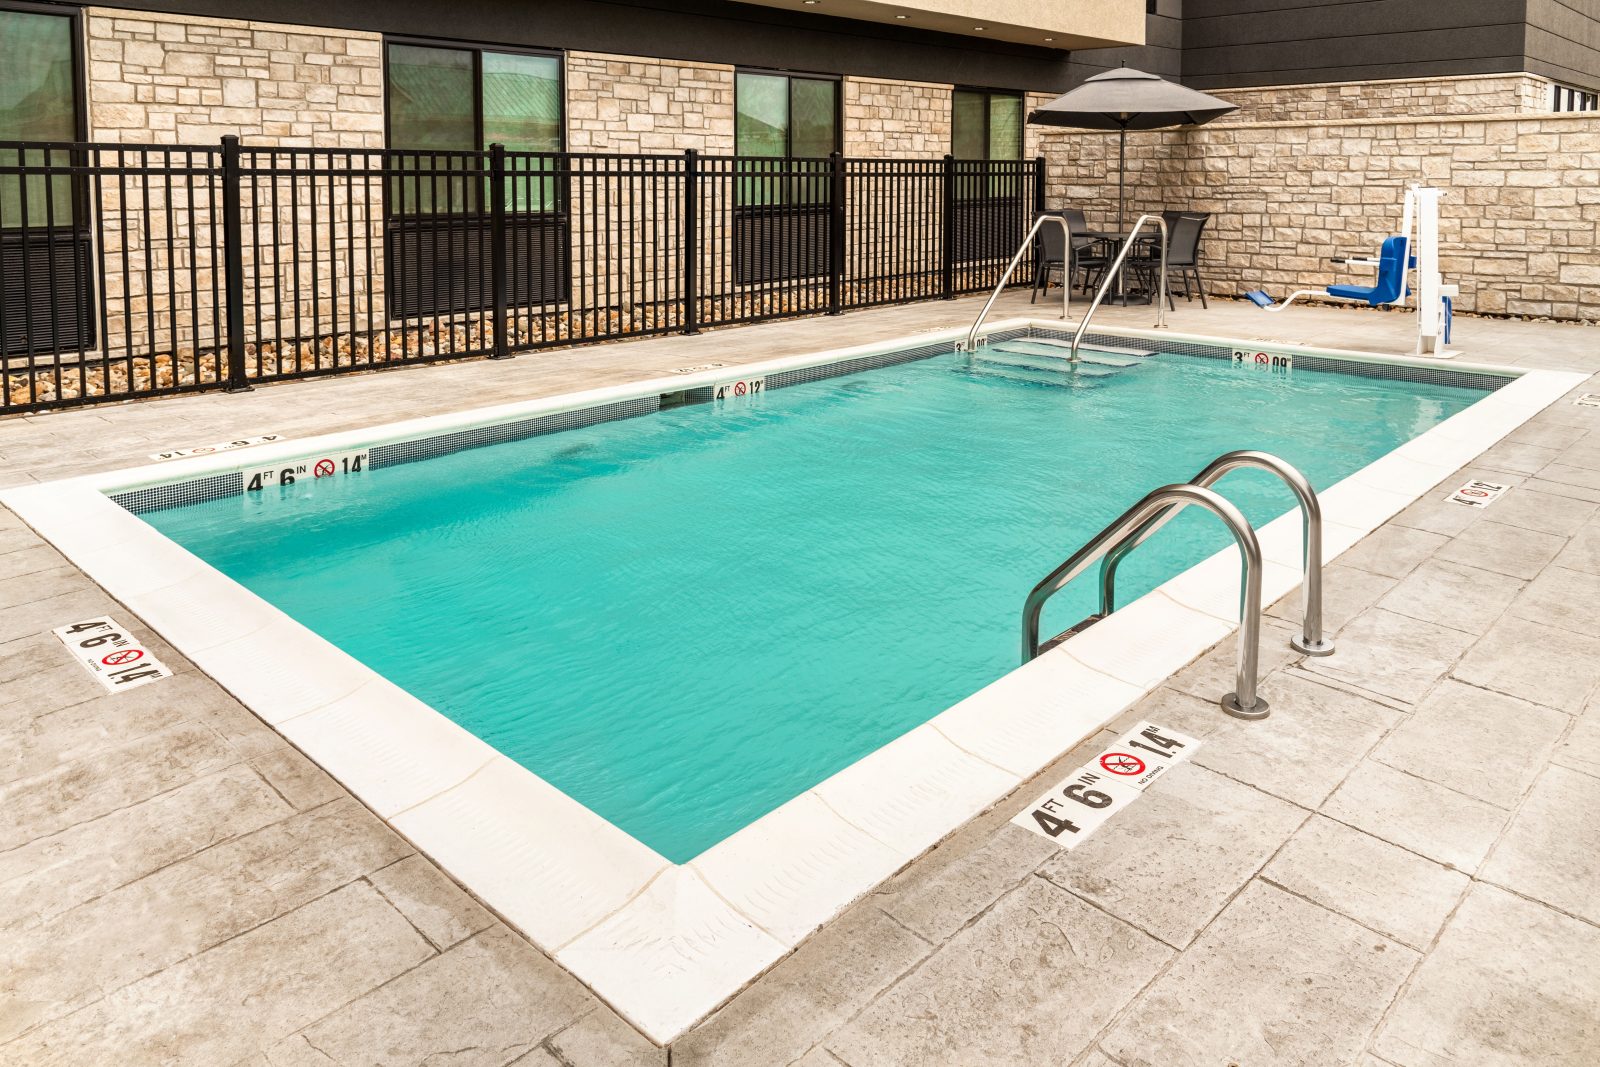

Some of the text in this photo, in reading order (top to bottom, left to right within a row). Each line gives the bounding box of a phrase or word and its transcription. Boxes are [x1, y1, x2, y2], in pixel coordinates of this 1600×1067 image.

[716, 386, 725, 399] 4
[247, 472, 264, 492] 4
[1138, 765, 1164, 785] NO DIVING
[1031, 809, 1081, 838] 4
